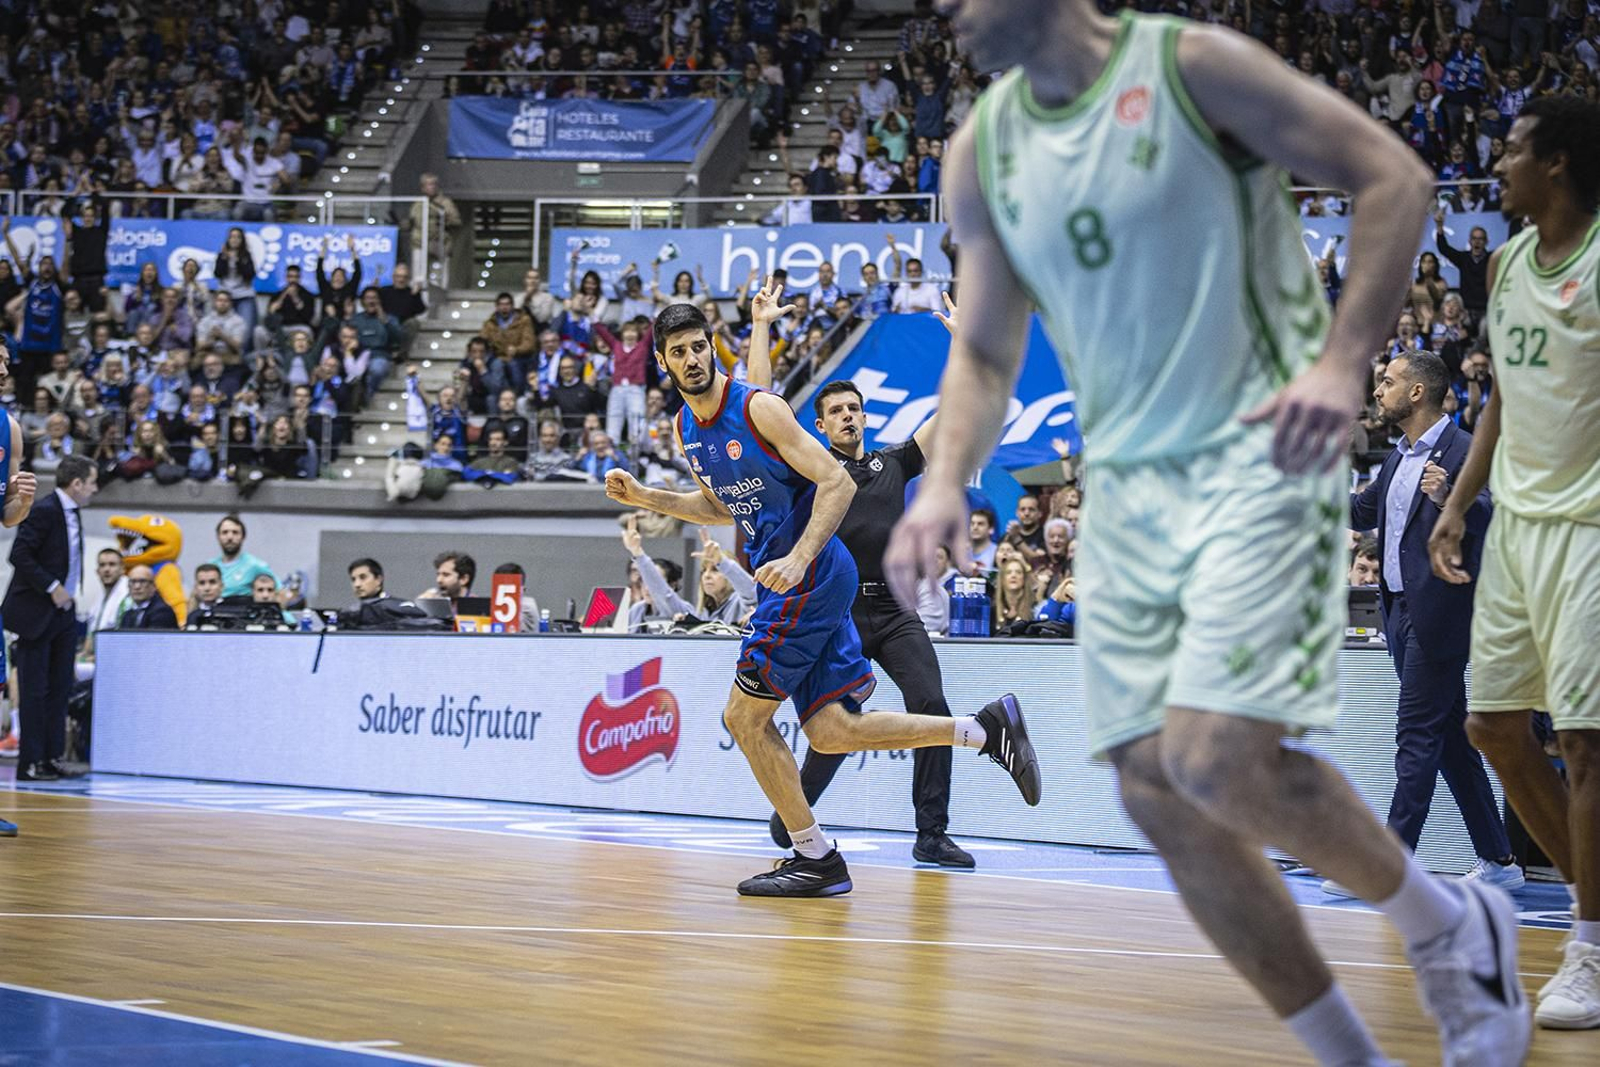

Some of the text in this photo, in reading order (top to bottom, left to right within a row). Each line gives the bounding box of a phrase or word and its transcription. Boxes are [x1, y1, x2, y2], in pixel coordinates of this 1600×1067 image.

[556, 111, 620, 126] HOTELES
[556, 128, 655, 143] RESTAURANTE
[1064, 207, 1114, 272] 8
[1506, 326, 1549, 367] 32
[494, 584, 517, 623] 5
[358, 692, 542, 750] Saber disfrutar
